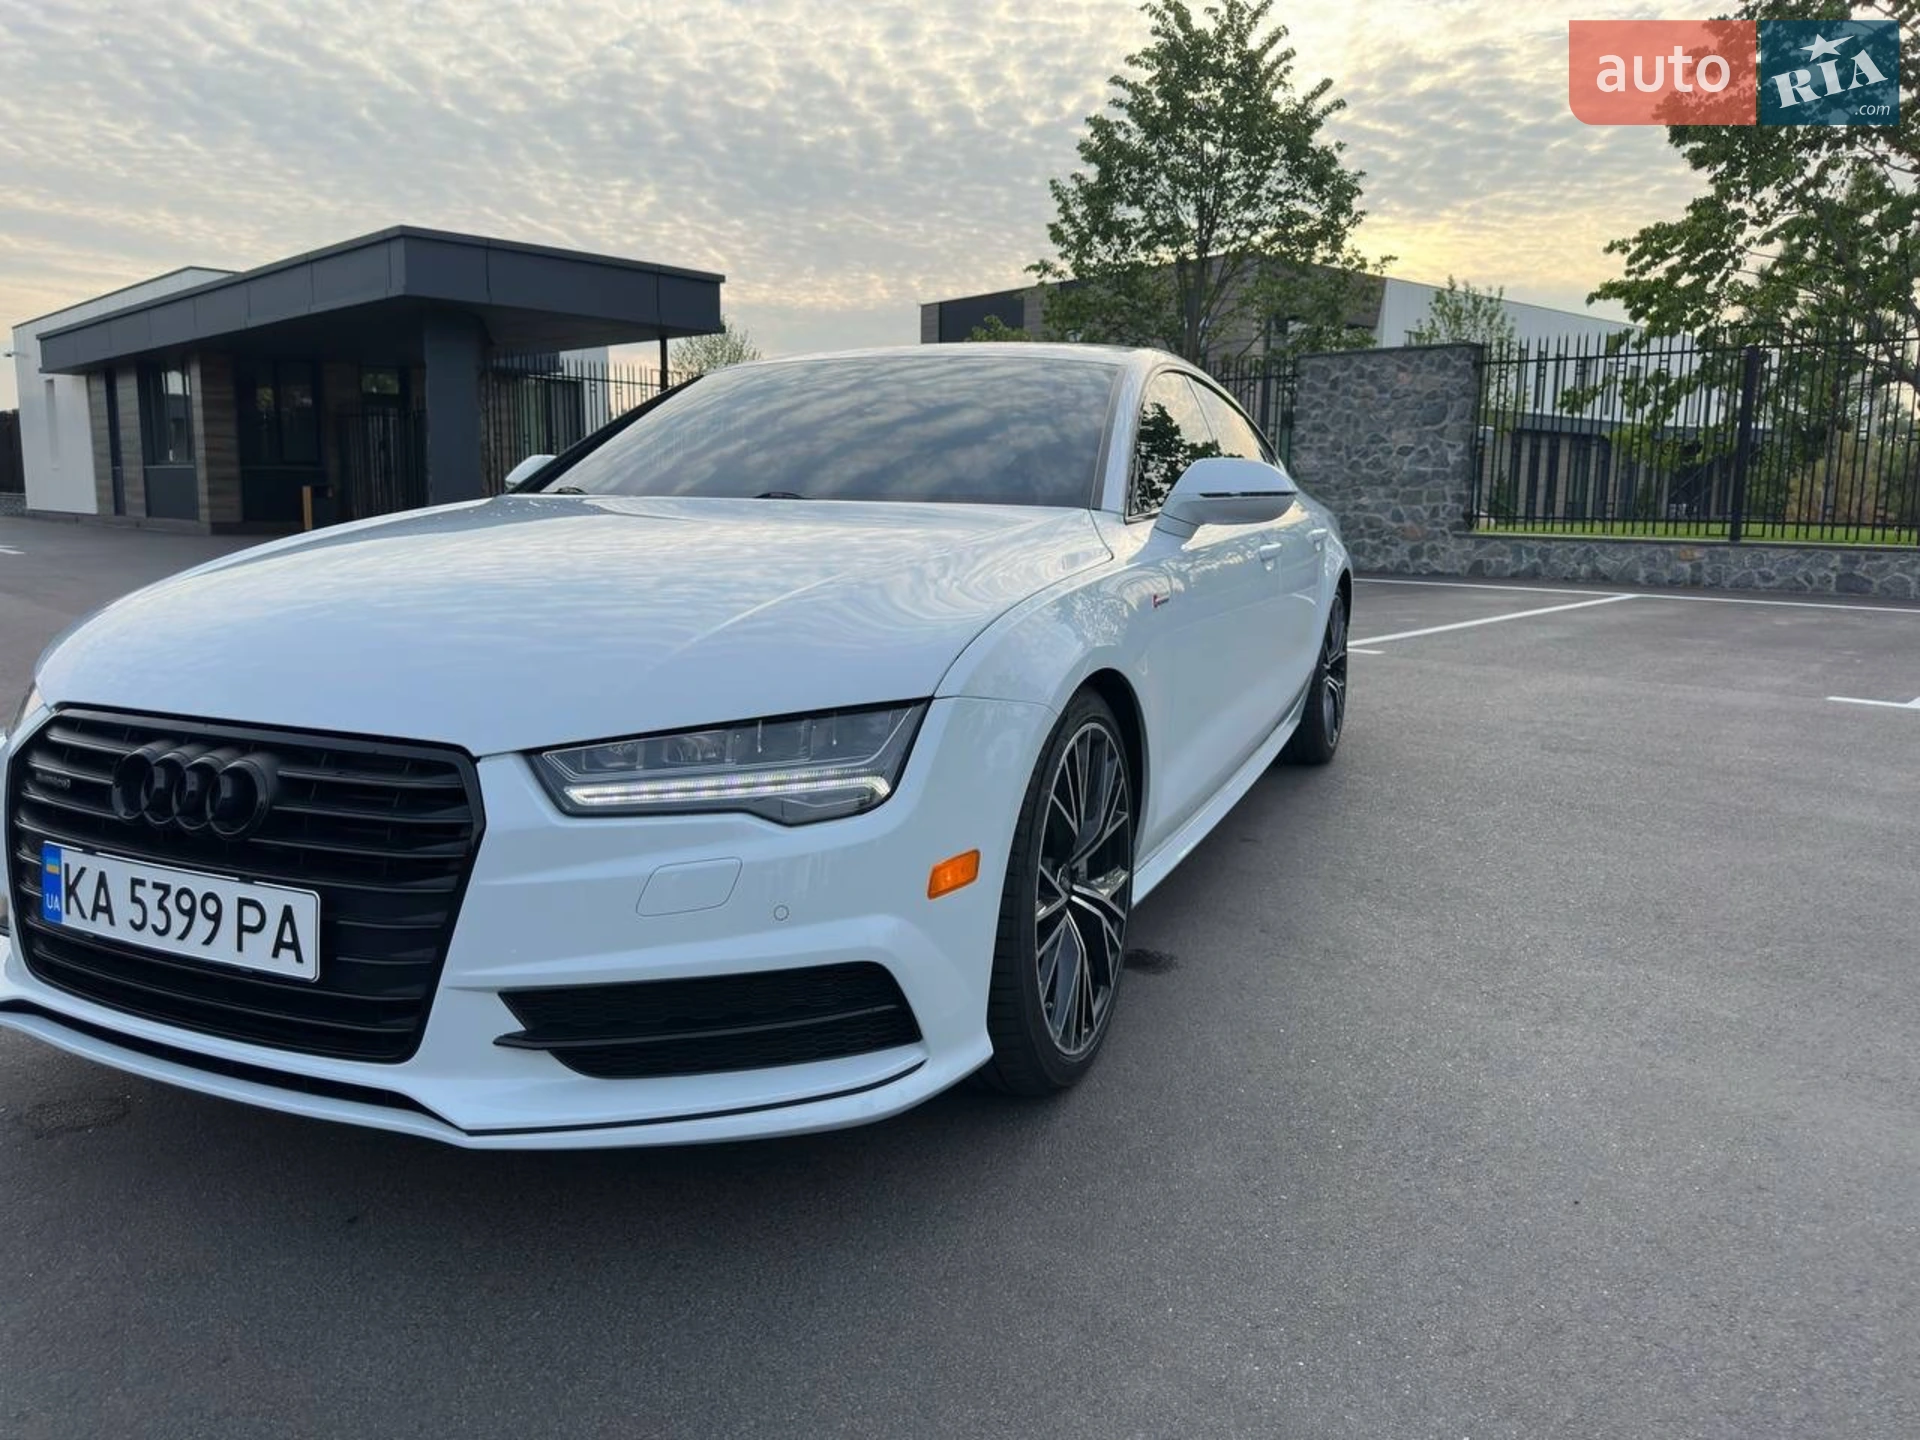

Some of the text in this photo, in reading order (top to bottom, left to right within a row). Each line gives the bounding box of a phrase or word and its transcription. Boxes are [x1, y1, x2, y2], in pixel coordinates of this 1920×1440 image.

[45, 893, 61, 911] UA
[64, 863, 304, 964] KA 5399 PA
